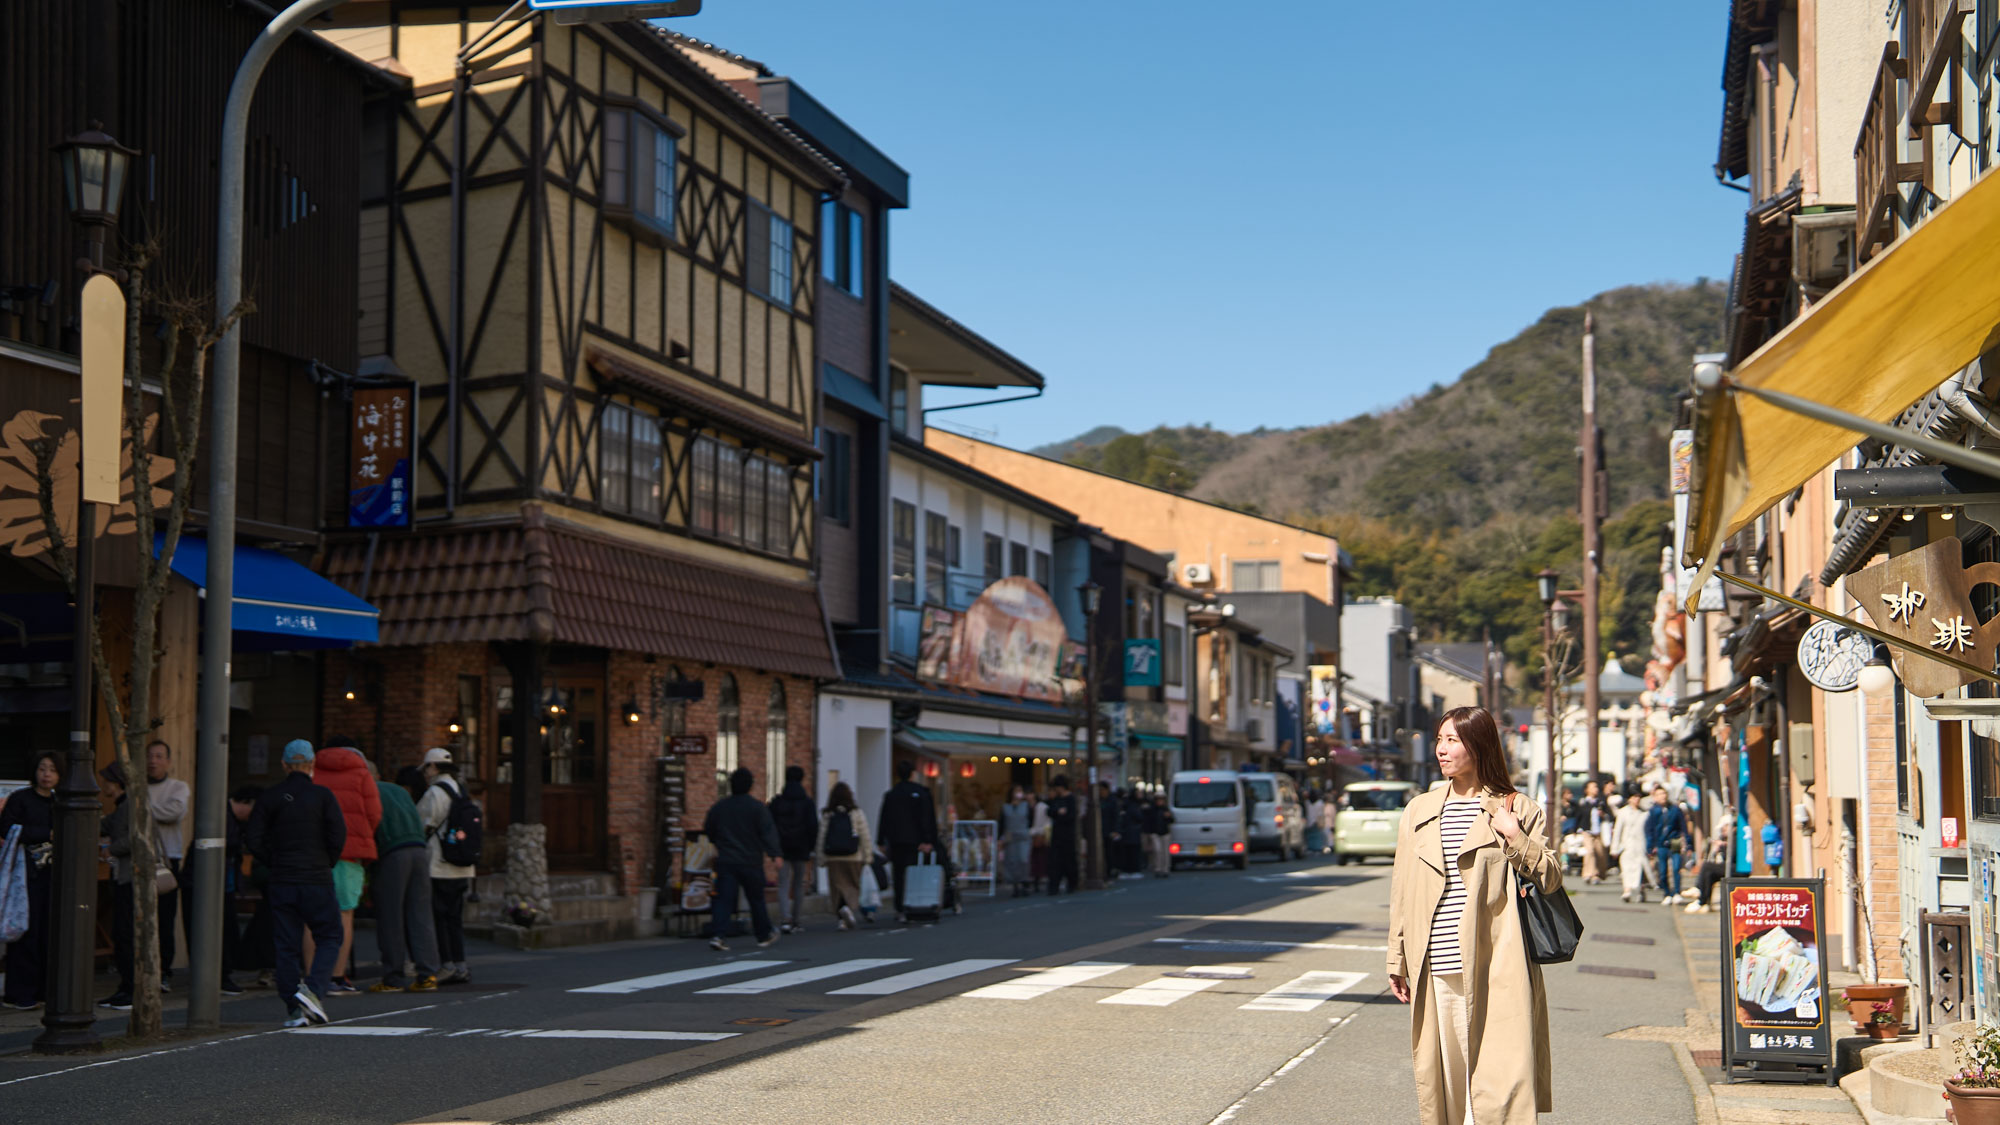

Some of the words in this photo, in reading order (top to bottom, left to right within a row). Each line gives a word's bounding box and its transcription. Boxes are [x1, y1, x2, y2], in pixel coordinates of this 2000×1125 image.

[1881, 581, 1975, 653] 珈琲
[1735, 902, 1811, 919] かにサンドイッチ
